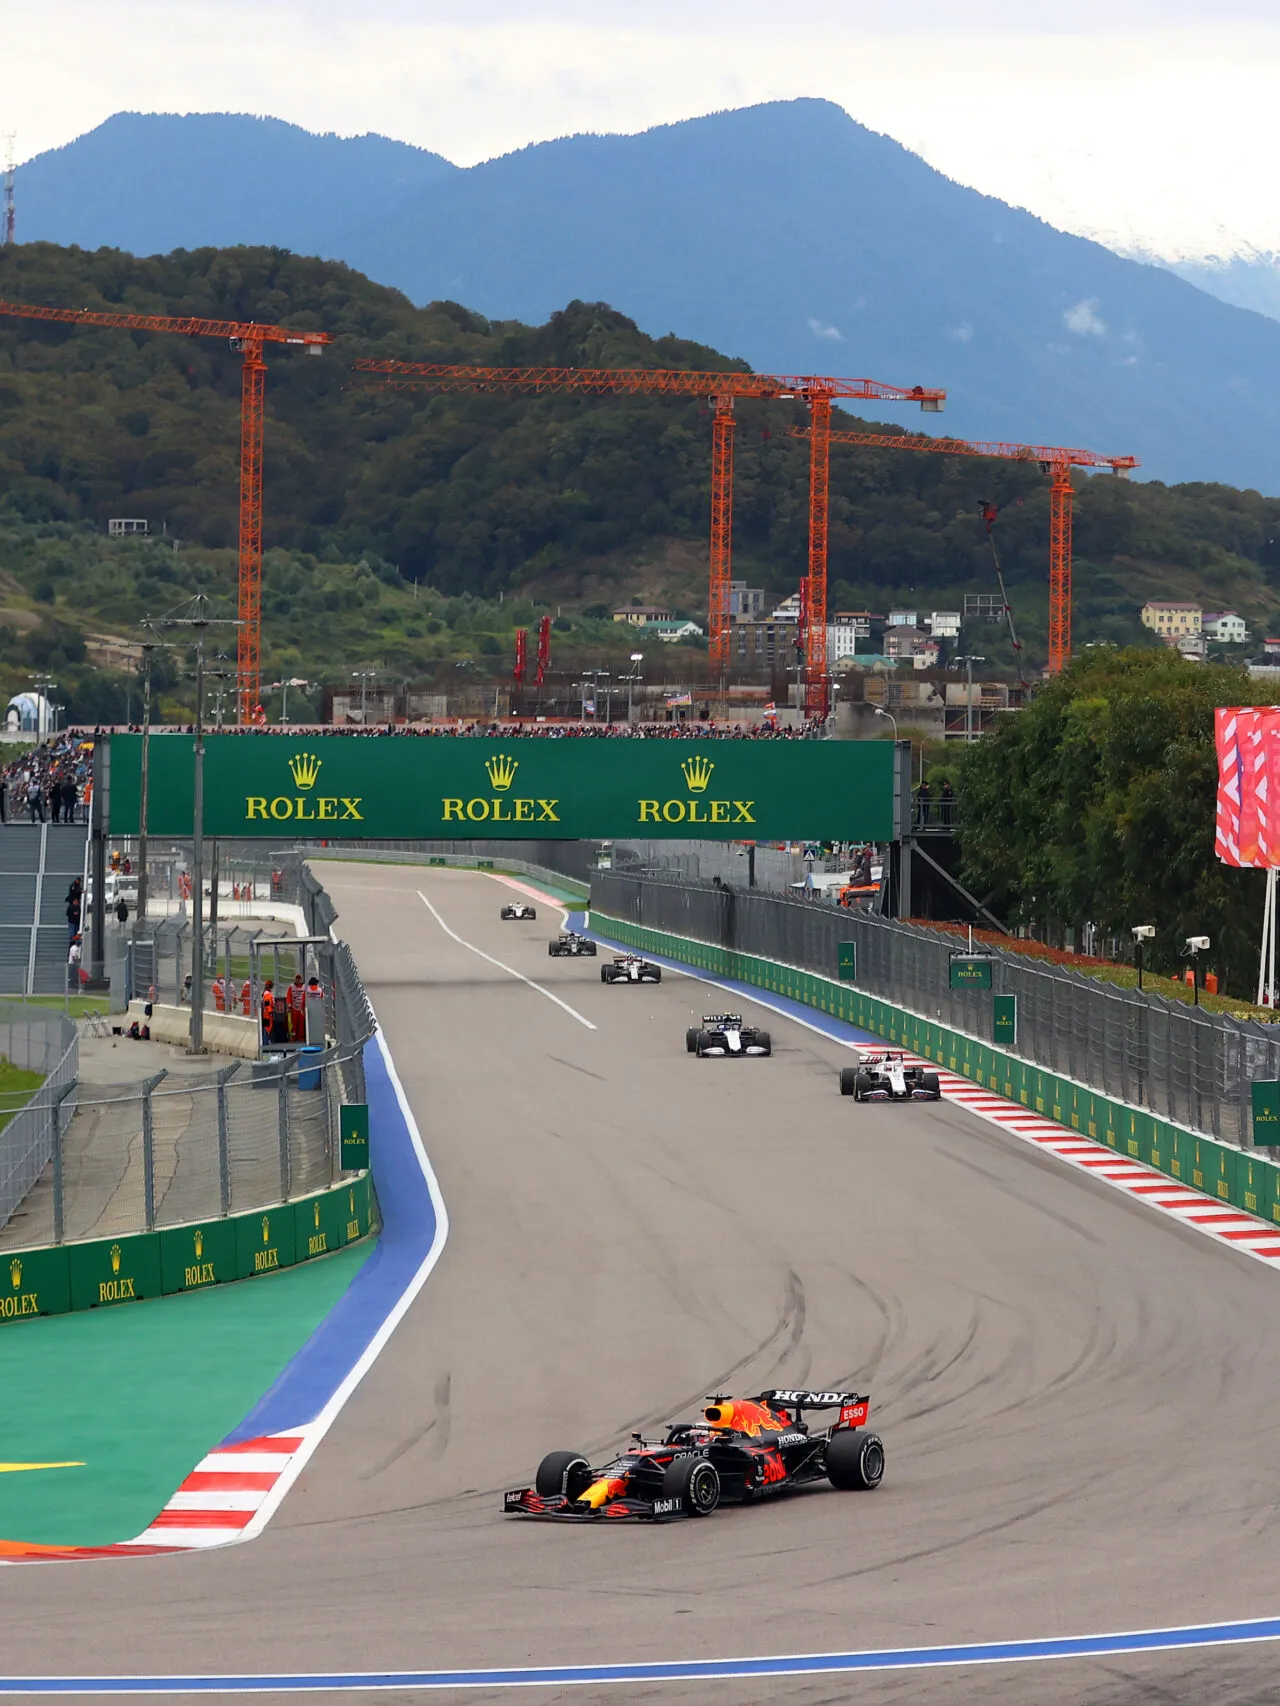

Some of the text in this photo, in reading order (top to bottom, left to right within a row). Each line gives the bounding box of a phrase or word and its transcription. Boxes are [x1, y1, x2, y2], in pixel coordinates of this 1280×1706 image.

[246, 796, 364, 820] ROLEX
[442, 797, 560, 821] ROLEX
[638, 799, 756, 823] ROLEX
[255, 1248, 278, 1271] ROLEX
[185, 1263, 215, 1286] ROLEX
[99, 1278, 135, 1302] ROLEX
[843, 1407, 864, 1420] ESSO
[777, 1433, 807, 1445] HONDA
[674, 1448, 710, 1461] ORACLE
[654, 1499, 673, 1514] Mobil
